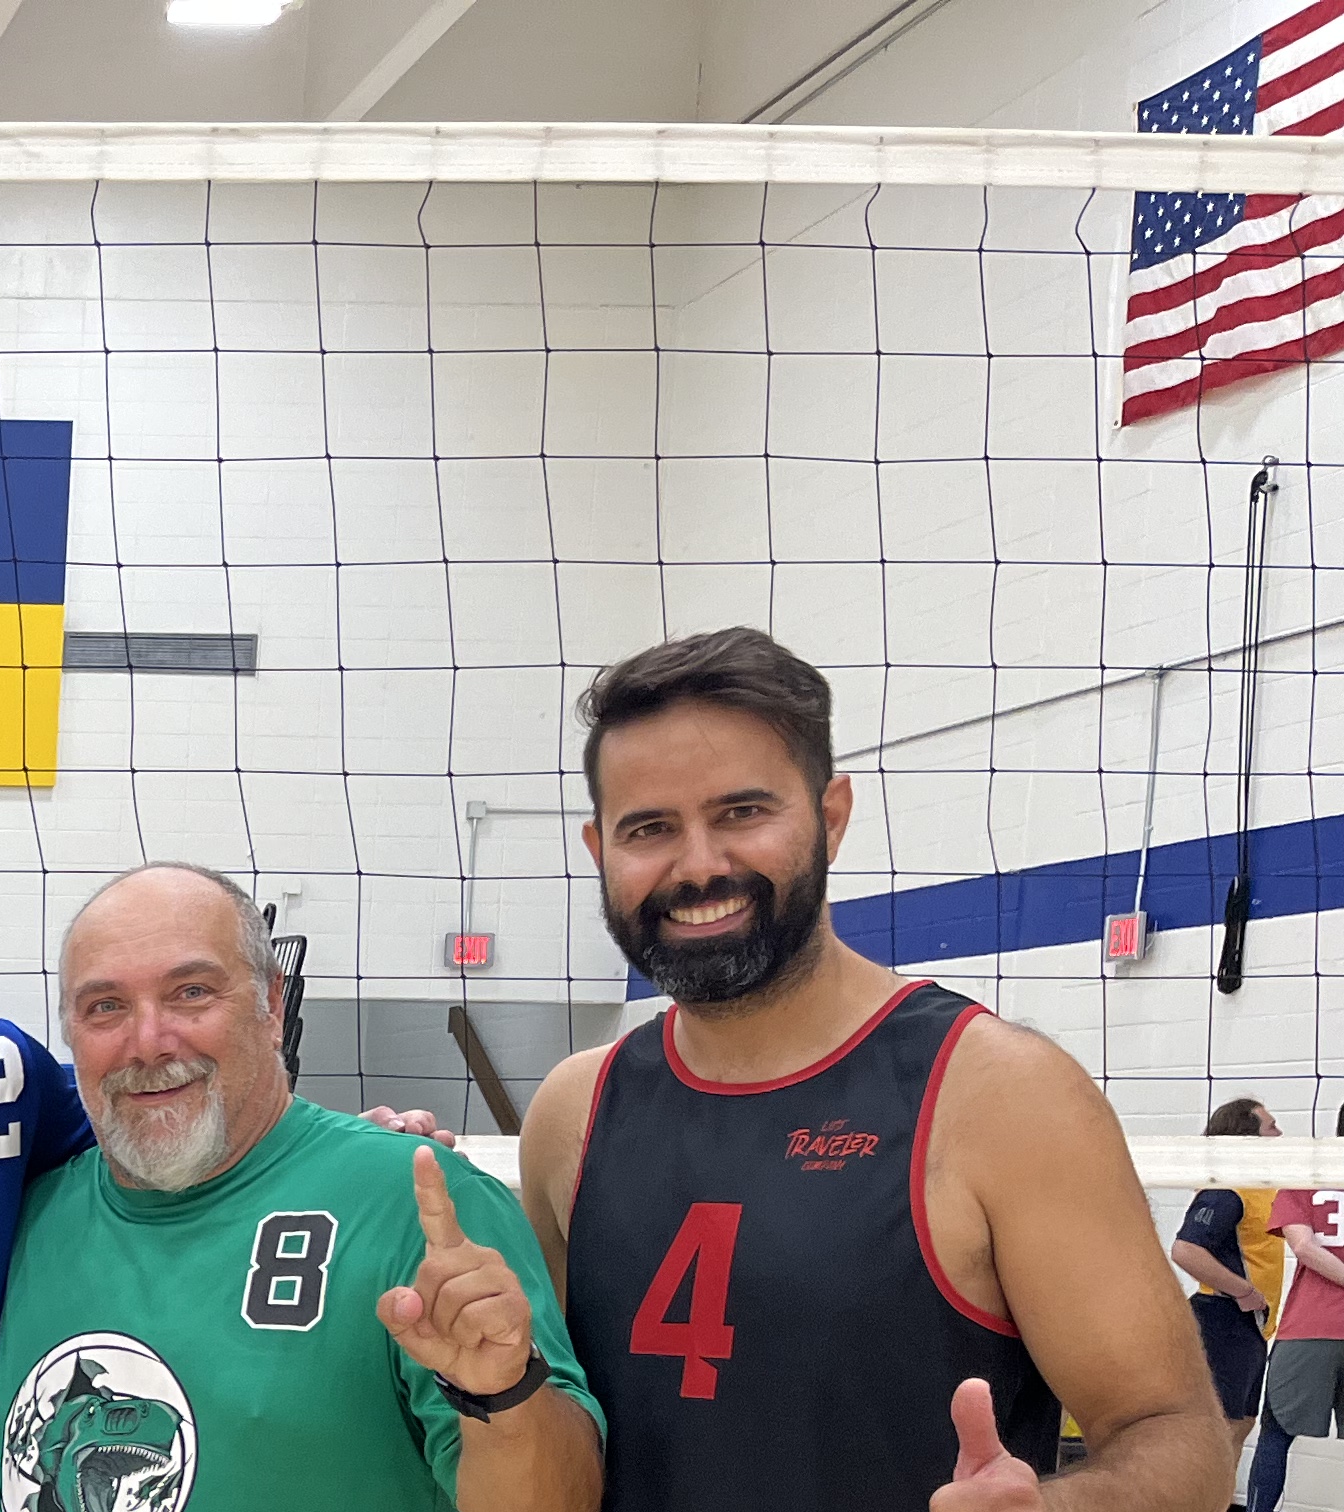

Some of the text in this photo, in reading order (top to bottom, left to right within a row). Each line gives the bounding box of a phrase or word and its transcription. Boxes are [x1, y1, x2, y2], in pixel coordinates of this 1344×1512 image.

[453, 935, 491, 965] EXIT
[784, 1128, 880, 1160] TRAVELER
[240, 1210, 339, 1331] 8
[629, 1202, 743, 1400] 4
